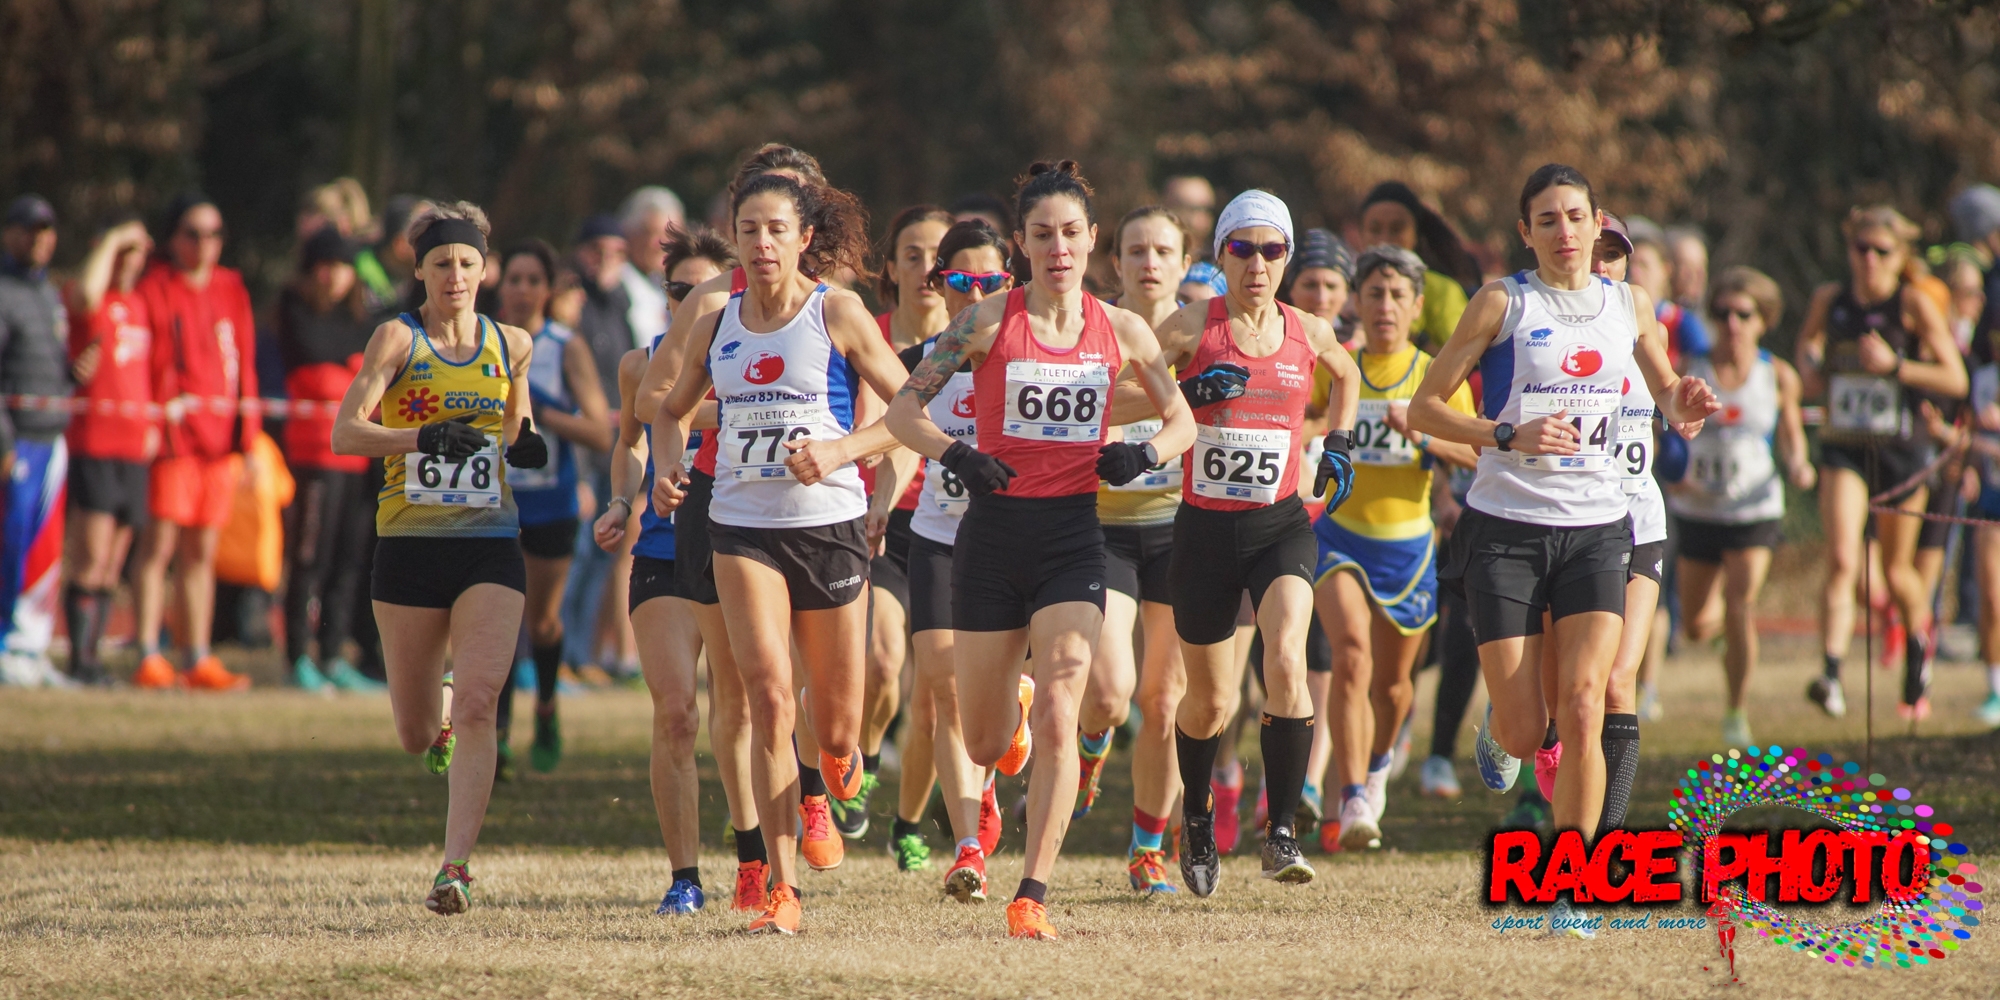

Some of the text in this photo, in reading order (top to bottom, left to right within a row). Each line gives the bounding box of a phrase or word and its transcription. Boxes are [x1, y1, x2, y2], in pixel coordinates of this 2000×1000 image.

[717, 353, 738, 362] KARHU
[1079, 351, 1104, 360] Circolo
[1275, 362, 1299, 372] Circolo
[1034, 368, 1086, 379] ATLETICA
[1277, 371, 1305, 381] Minerva
[1570, 383, 1587, 394] 85
[758, 391, 774, 402] 85
[1018, 385, 1098, 423] 668
[1548, 398, 1600, 407] ATLETICA
[747, 410, 797, 421] ATLETICA
[1218, 433, 1269, 443] ATLETICA
[417, 454, 492, 490] 678
[1203, 447, 1280, 486] 625
[829, 574, 861, 591] macron
